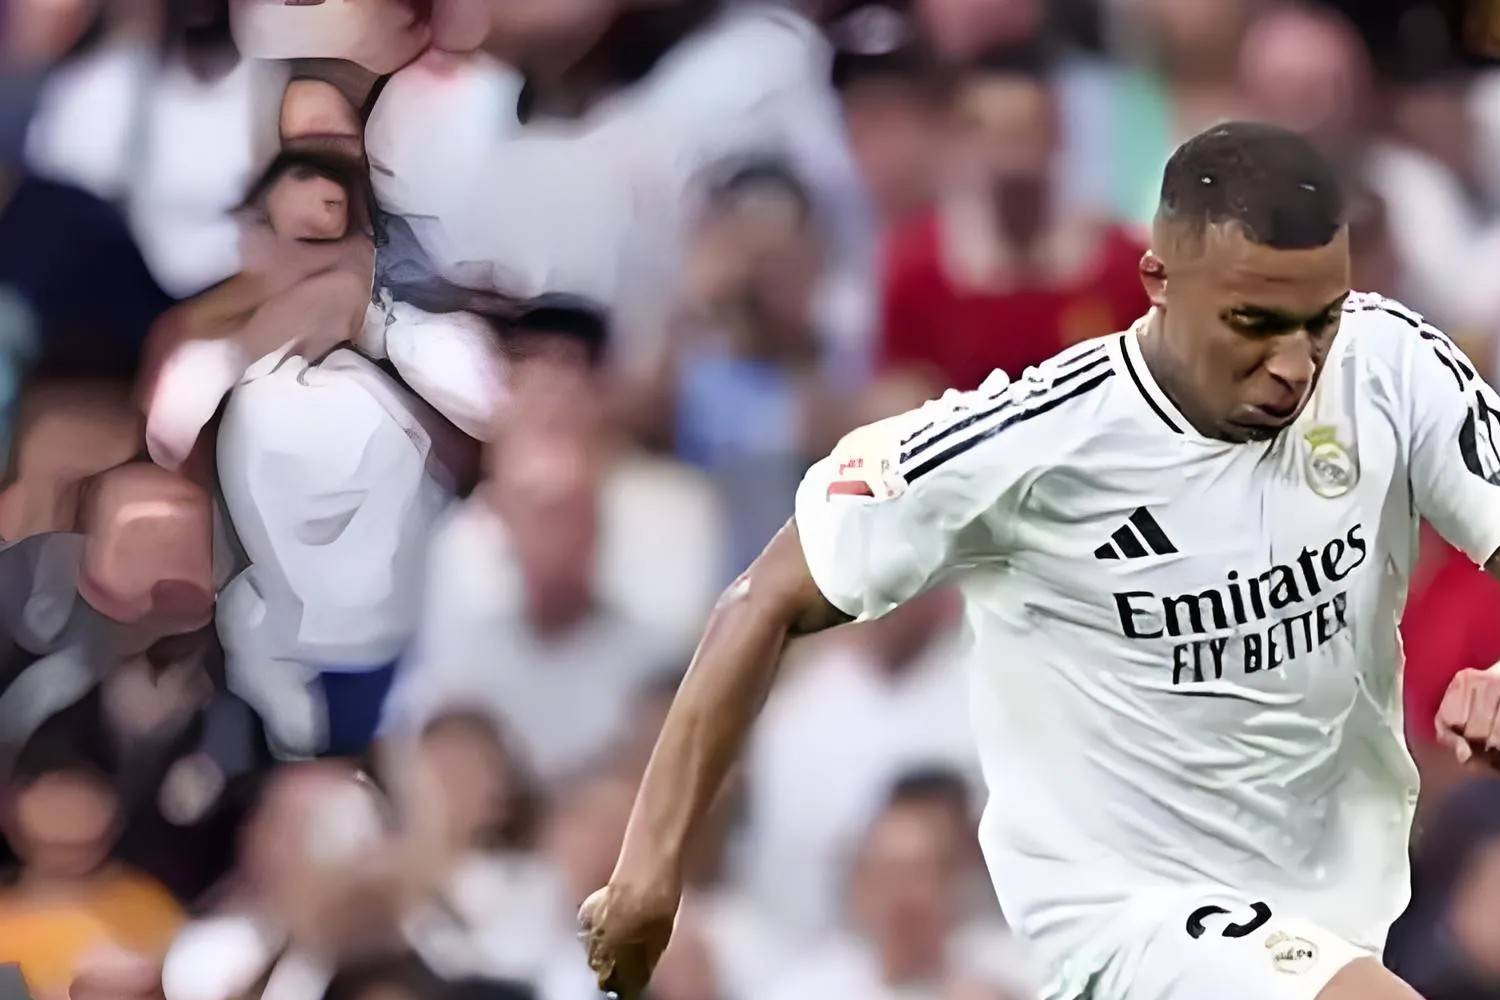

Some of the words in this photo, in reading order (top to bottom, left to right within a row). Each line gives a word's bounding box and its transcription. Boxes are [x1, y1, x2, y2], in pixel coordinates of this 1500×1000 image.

[1113, 523, 1366, 638] Emirates
[1173, 637, 1229, 685] FLY
[1243, 591, 1347, 674] BETTER
